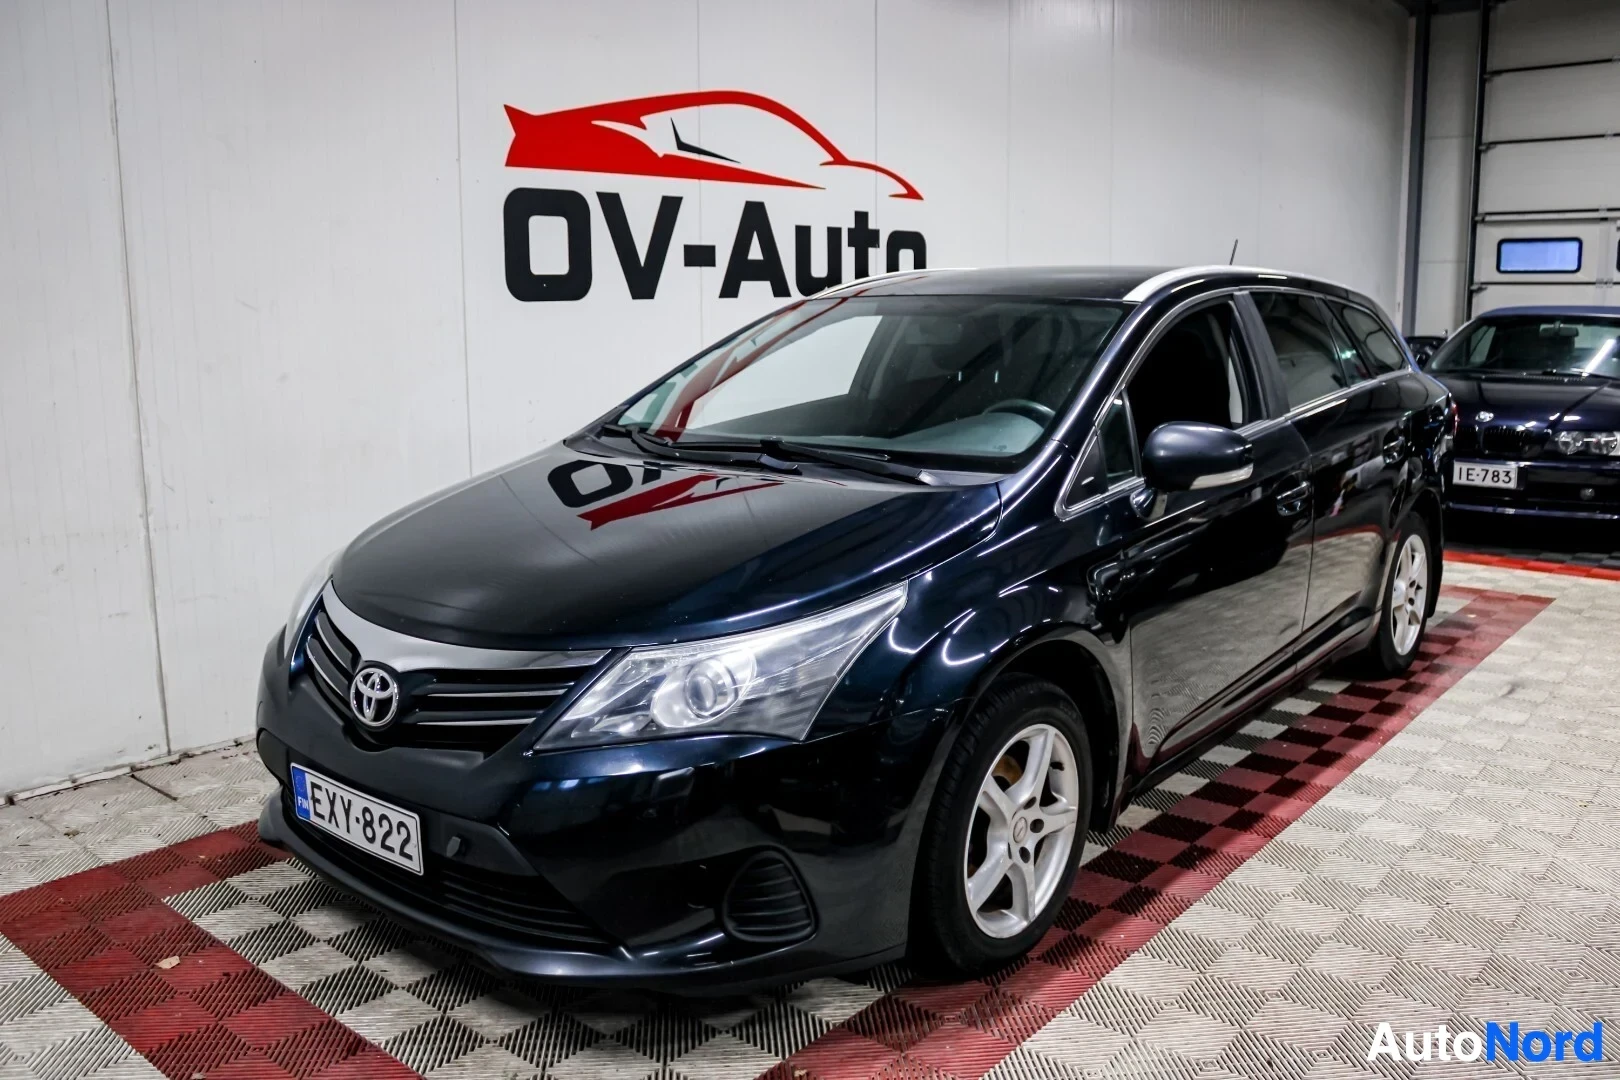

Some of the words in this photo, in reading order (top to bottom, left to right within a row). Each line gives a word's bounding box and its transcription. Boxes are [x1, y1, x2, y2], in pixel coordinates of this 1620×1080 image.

[1458, 466, 1512, 484] IE-783
[297, 795, 309, 810] FIN
[310, 781, 414, 862] EXY-822
